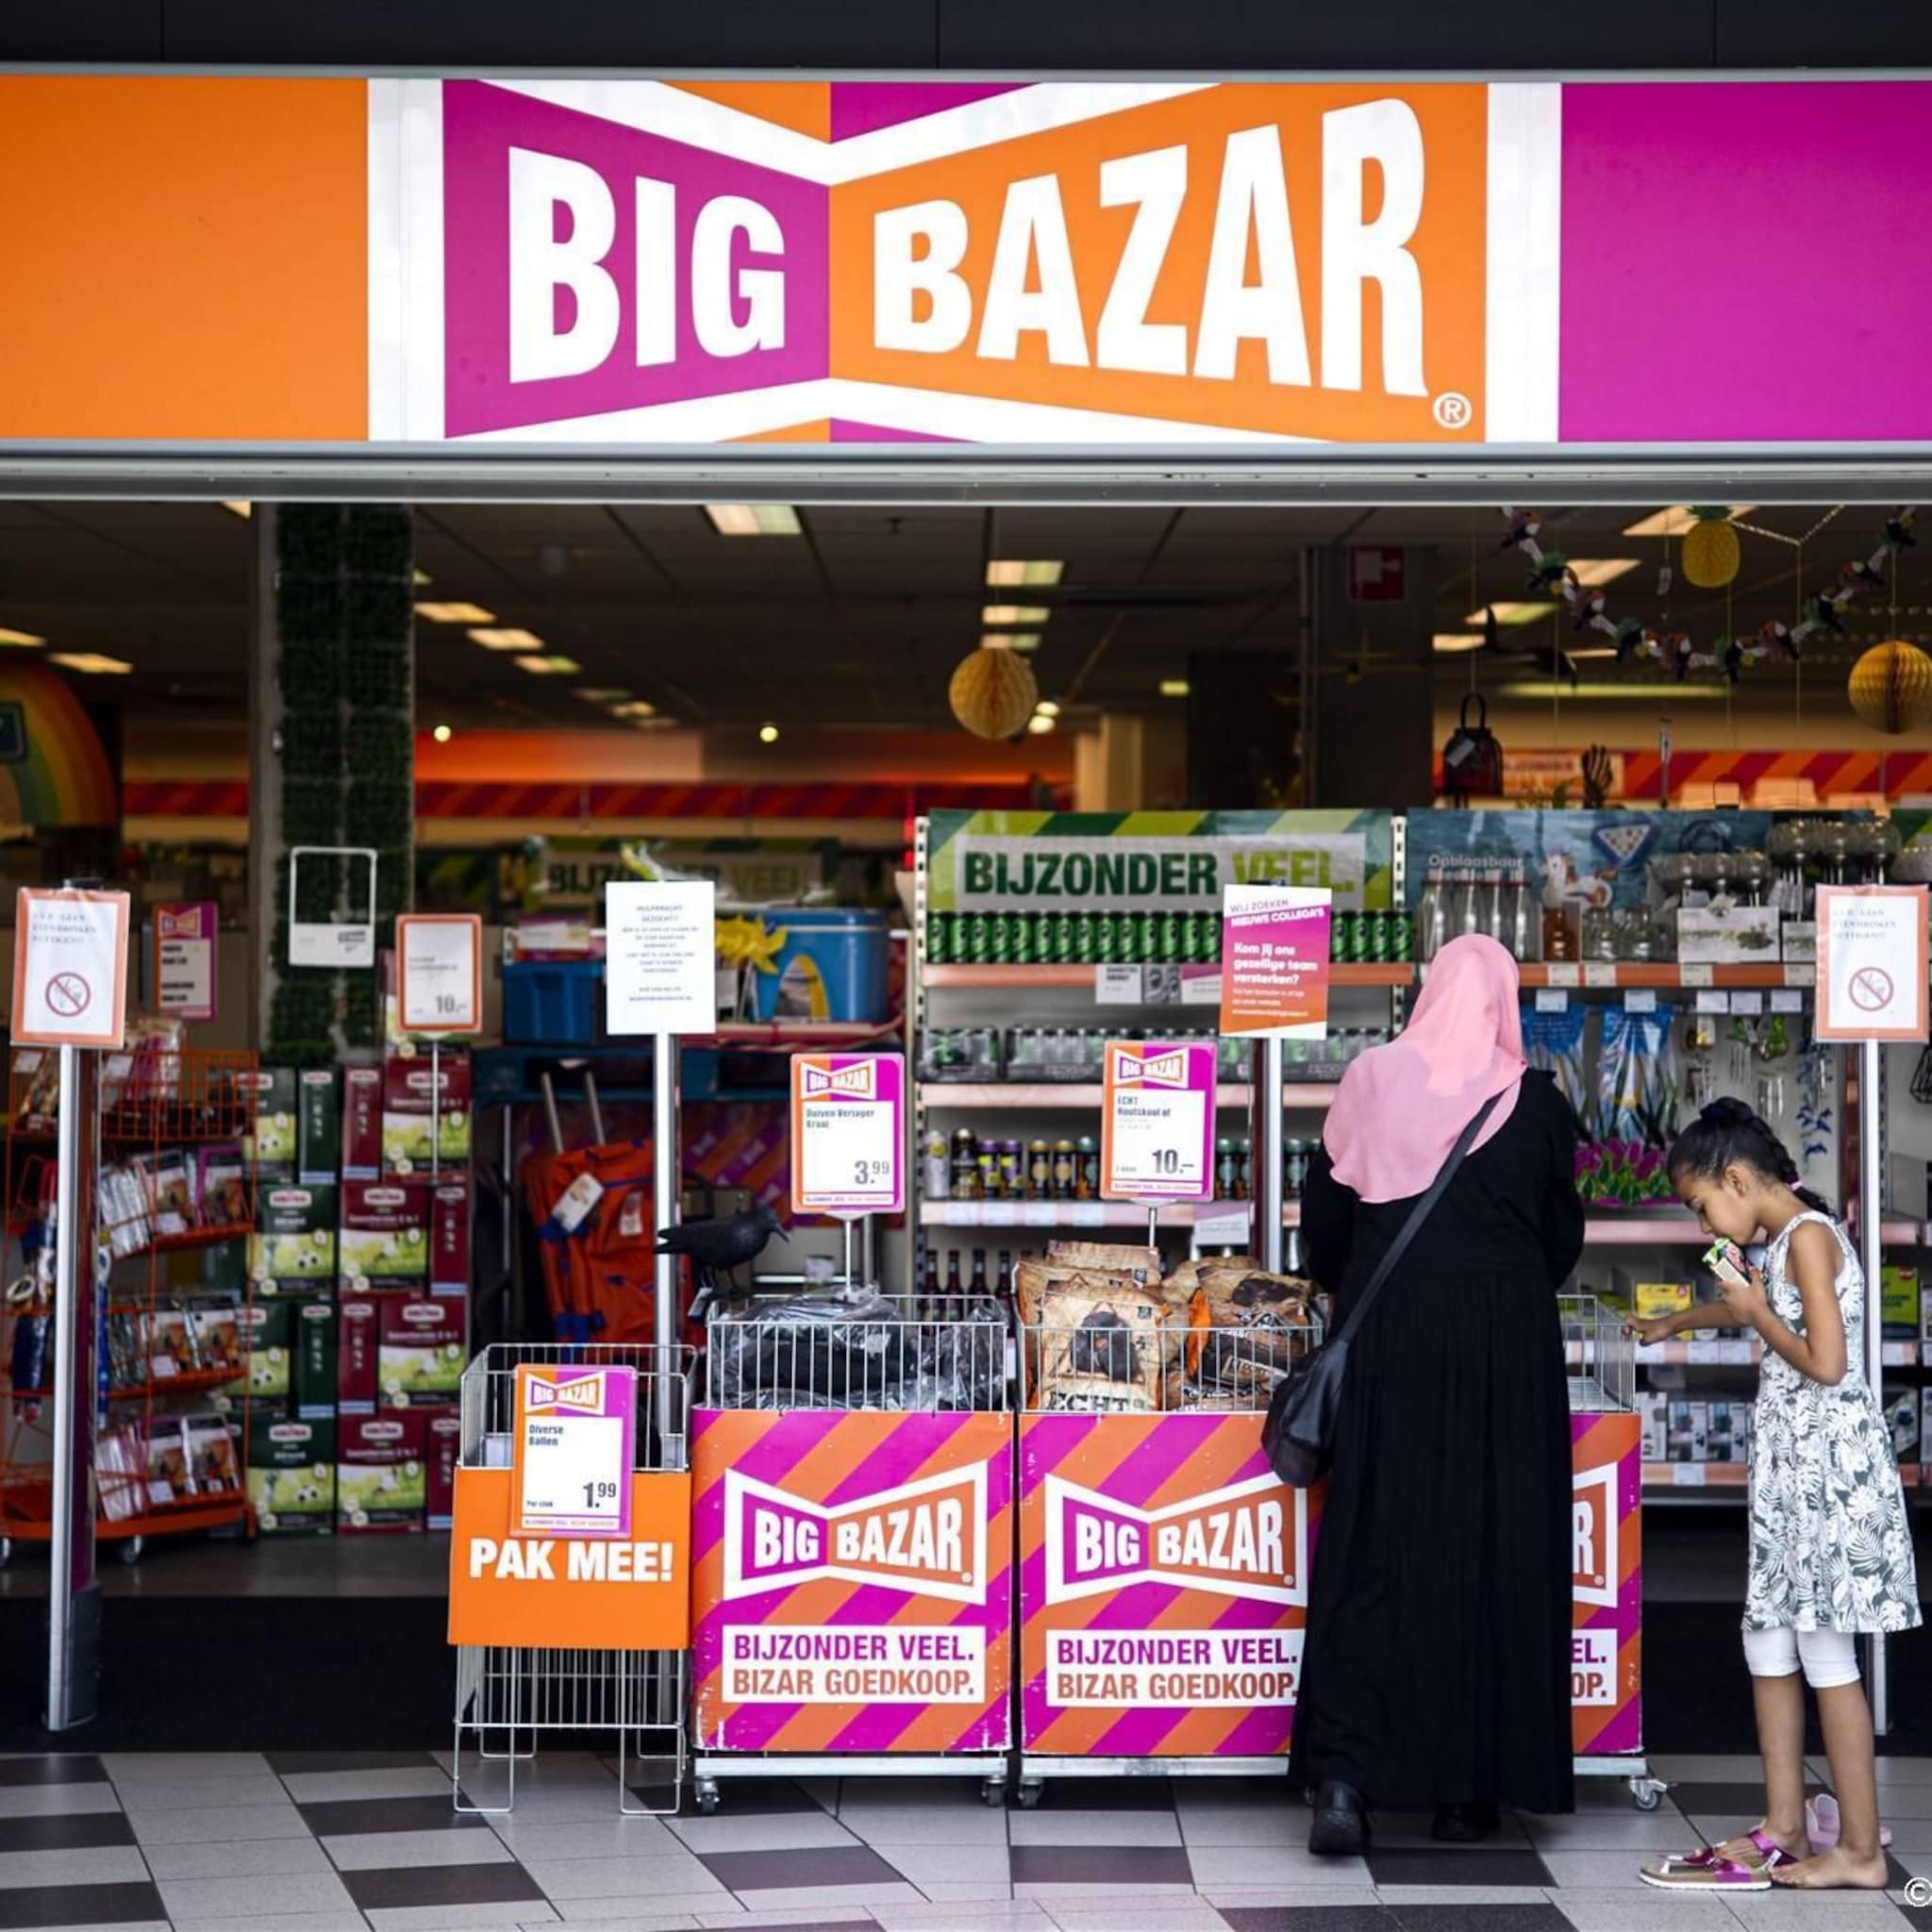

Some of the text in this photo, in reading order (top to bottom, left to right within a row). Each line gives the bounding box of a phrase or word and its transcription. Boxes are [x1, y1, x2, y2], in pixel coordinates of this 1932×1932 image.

[508, 146, 785, 383] BIG
[964, 851, 1218, 896] BIJZONDER
[1230, 898, 1290, 913] WIJ ZOEKEN
[1231, 908, 1324, 927] NIEUWE COLLEGA'S
[1233, 942, 1295, 958] Kom jij ons
[1233, 958, 1318, 972] gezellige team
[1233, 974, 1300, 985] versterken?
[809, 1067, 869, 1092] BIG BAZAR
[1123, 1058, 1141, 1078] BIG
[1144, 1056, 1181, 1081] BAZAR
[807, 1108, 836, 1118] Duiven
[855, 1159, 890, 1185] 3.99
[534, 1379, 597, 1407] BIG BAZAR
[1046, 1391, 1128, 1411] ECHT
[528, 1424, 564, 1435] Diverse
[528, 1436, 559, 1446] Ballen
[583, 1481, 617, 1508] 1.99
[754, 1496, 963, 1573] BIG BAZAR
[1075, 1499, 1285, 1575] BIG BAZAR
[469, 1538, 674, 1582] PAK MEE!
[734, 1634, 974, 1661] BIJZONDER VEEL.
[1057, 1638, 1298, 1665] BIJZONDER VEEL.
[733, 1669, 974, 1695] BIZAR GOEDKOOP.
[1057, 1673, 1298, 1699] BIZAR GOEDKOOP.
